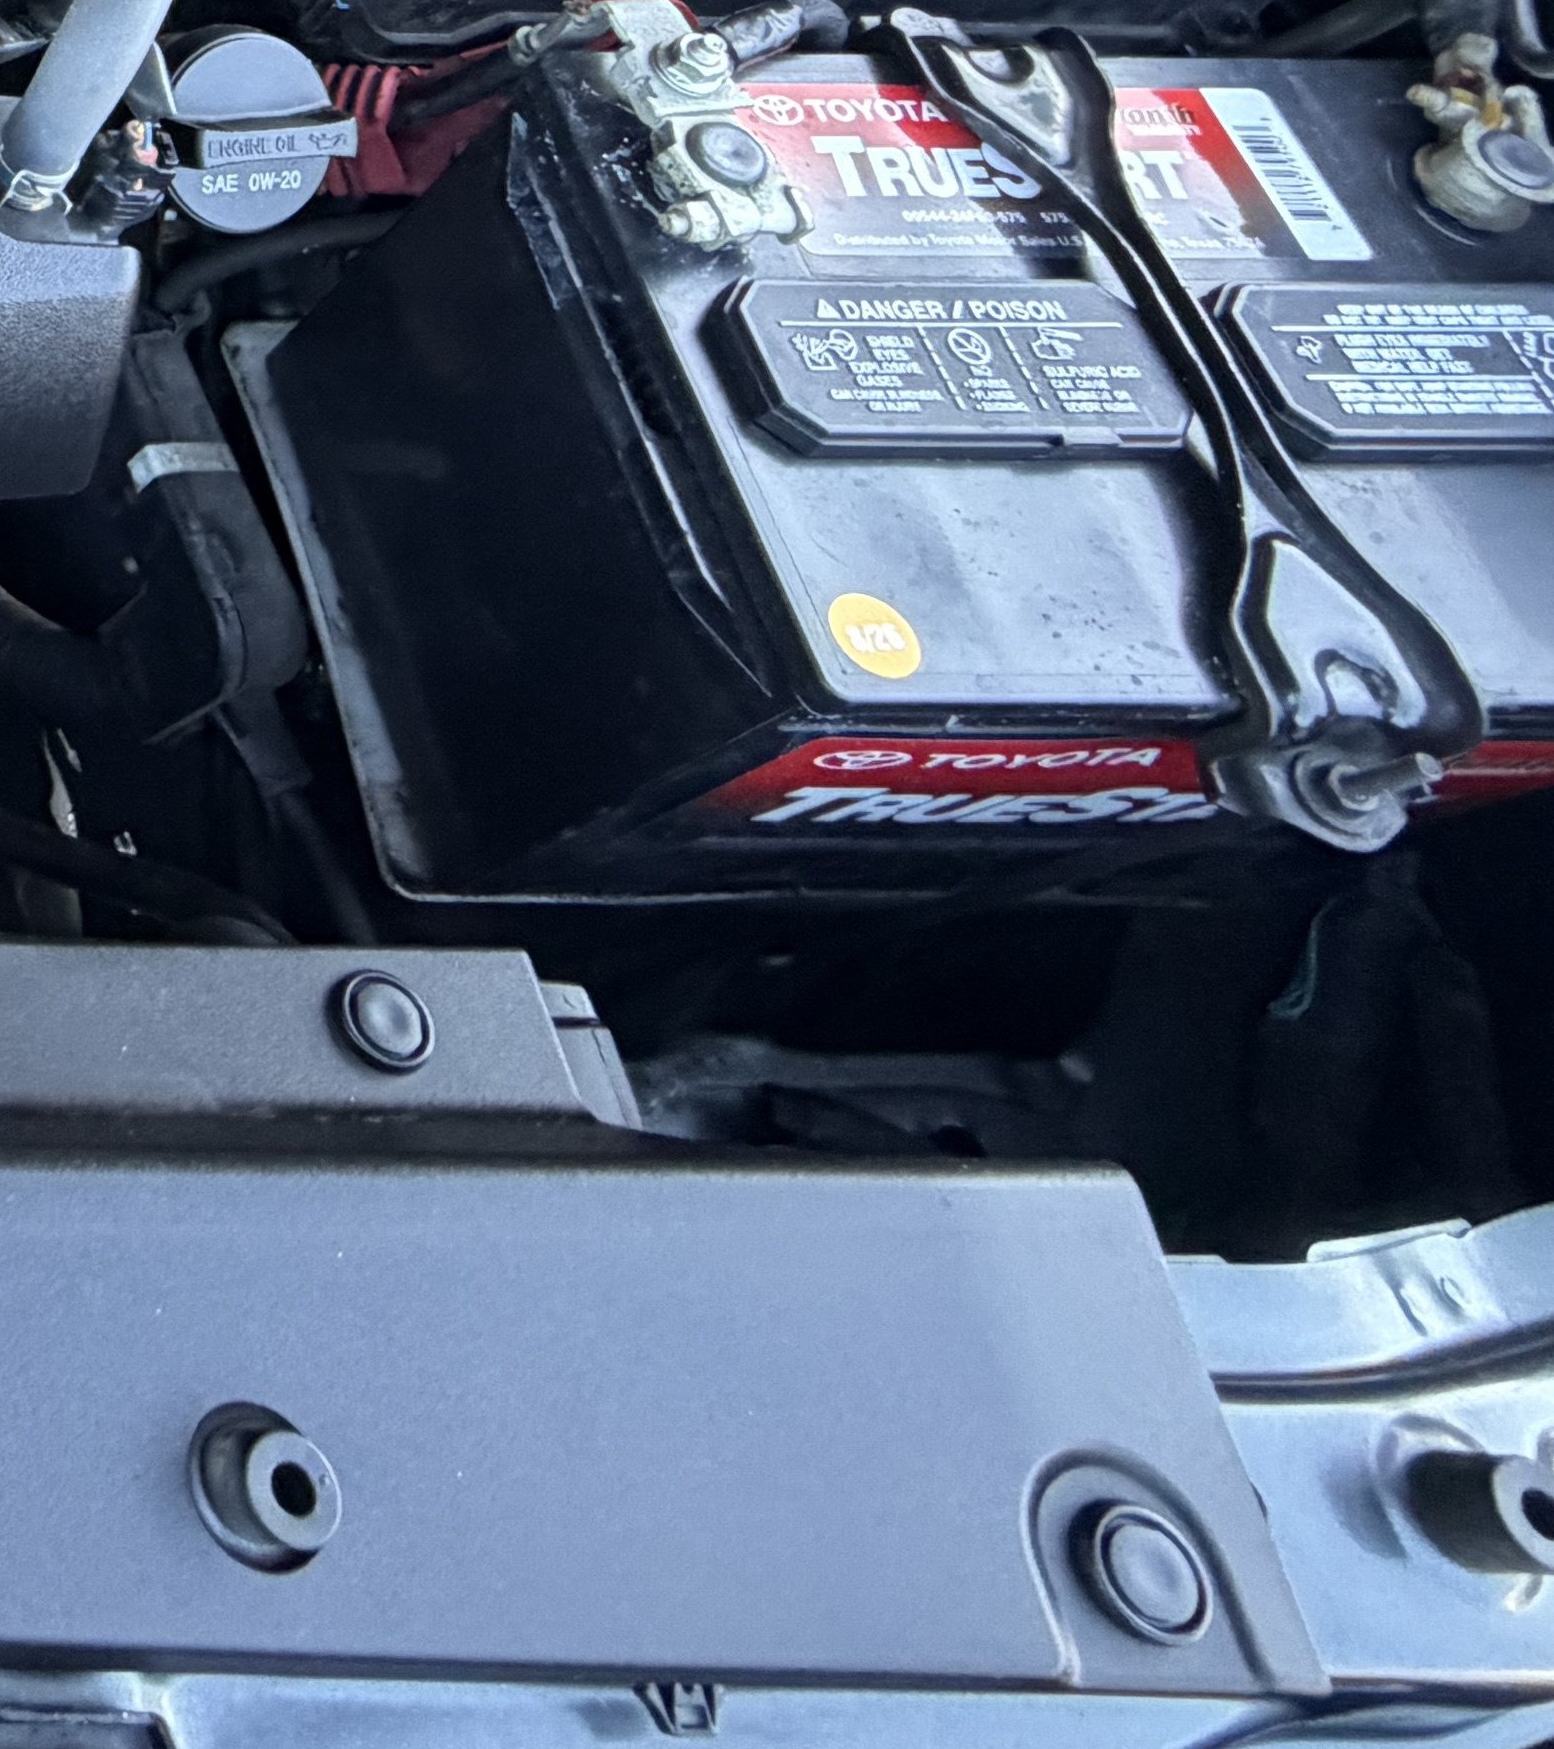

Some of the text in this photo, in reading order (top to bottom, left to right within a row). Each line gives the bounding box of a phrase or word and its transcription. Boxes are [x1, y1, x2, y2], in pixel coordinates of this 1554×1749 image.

[803, 98, 950, 123] TOYOTA
[206, 134, 298, 159] ENGINE OIL
[201, 170, 302, 195] SAE 0W-20
[838, 299, 948, 320] DANGER
[967, 299, 1068, 321] POISON
[919, 747, 1162, 771] TOYOTA
